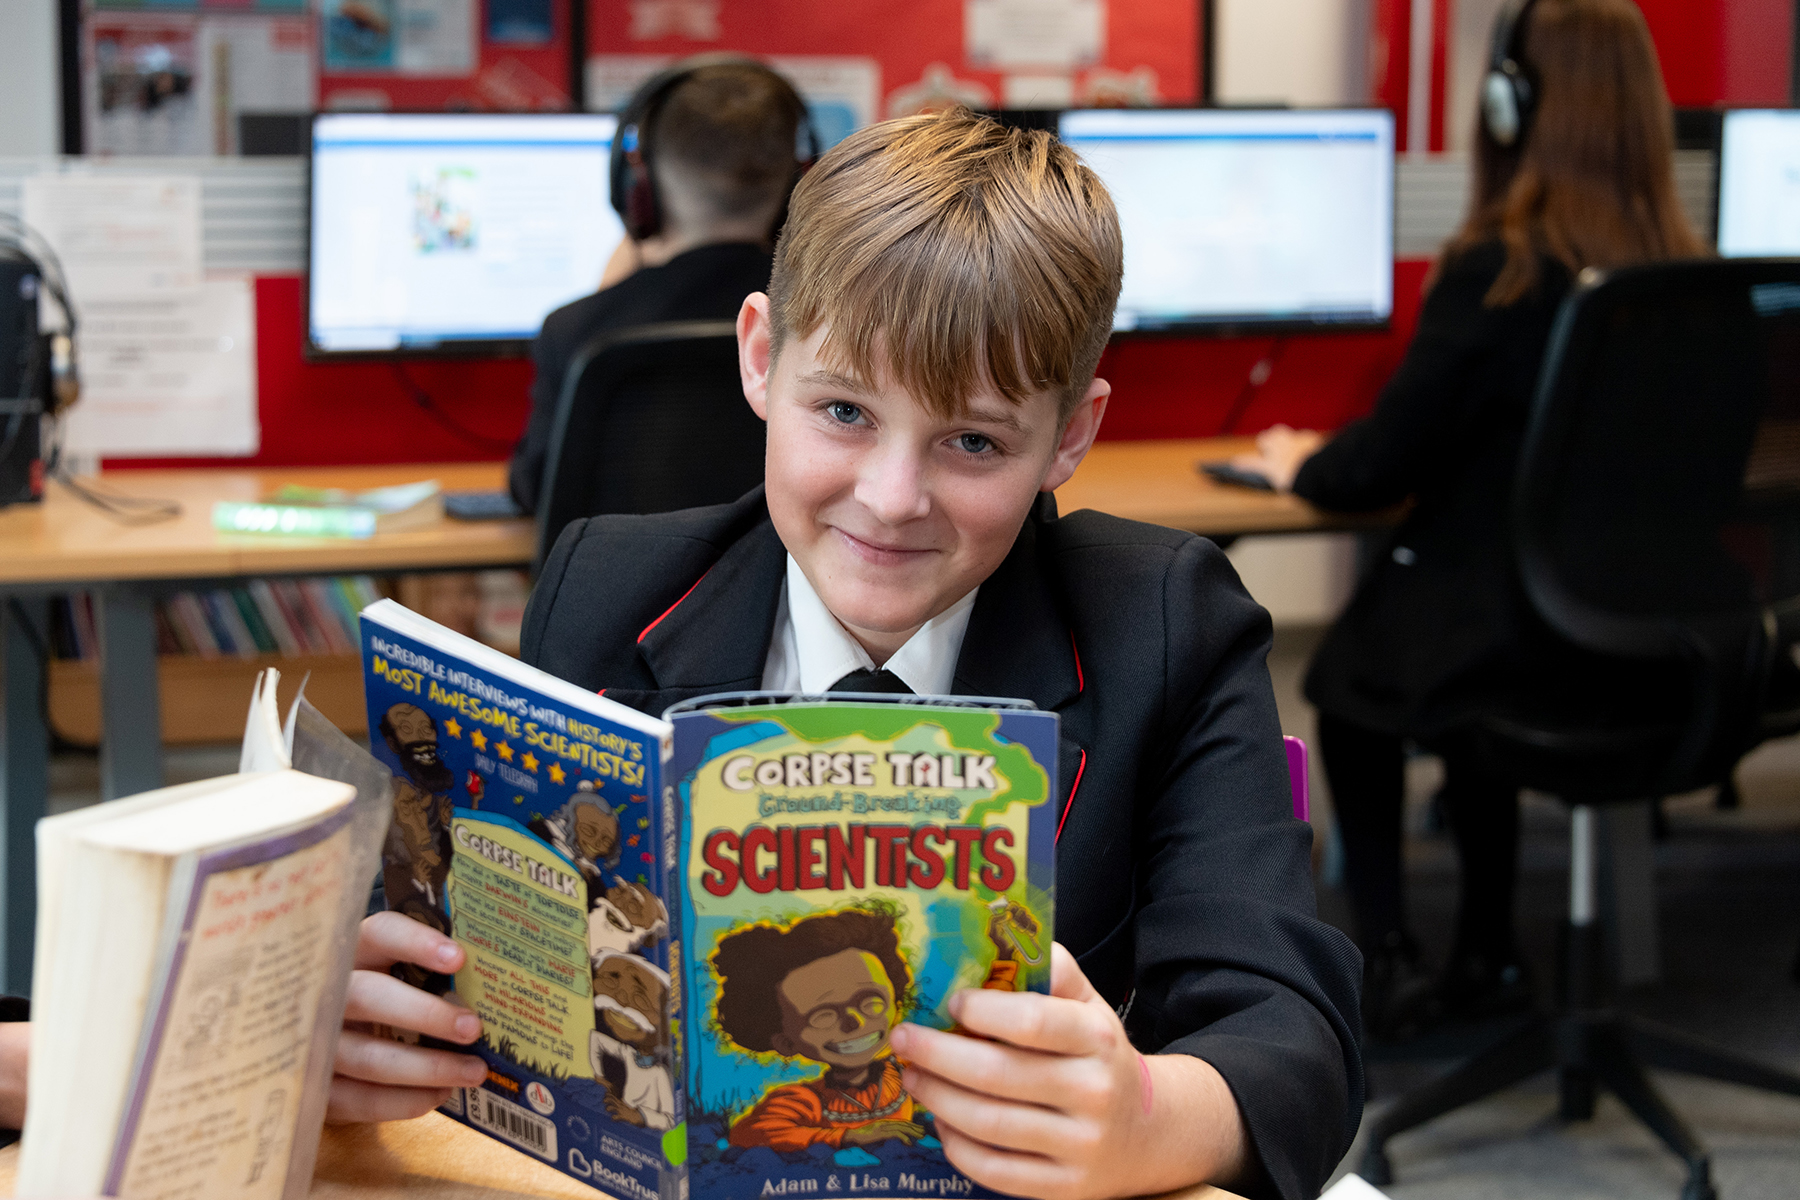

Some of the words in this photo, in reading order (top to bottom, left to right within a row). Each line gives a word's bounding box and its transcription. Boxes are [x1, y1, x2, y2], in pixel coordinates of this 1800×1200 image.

[371, 635, 446, 680] INCREDIBLE
[447, 667, 528, 717] INTERVIEWS
[528, 704, 566, 733] WITH
[567, 717, 642, 761] HISTORY'S
[372, 654, 424, 695] MOST
[427, 679, 522, 738] AWESOME
[523, 721, 645, 788] SCIENTISTS!
[721, 751, 876, 792] CORPSE
[886, 750, 998, 790] TALK
[757, 792, 963, 819] Ground-Breaking
[454, 821, 522, 874] CORPSE
[526, 855, 578, 901] TALK
[701, 823, 1017, 897] SCIENTISTS
[485, 881, 528, 909] DARWIN'S
[494, 873, 520, 893] TASTE
[535, 891, 578, 921] TORTOISE
[498, 905, 539, 933] EINSTEIN
[502, 947, 532, 969] DEADLY
[548, 957, 575, 978] MARIE
[474, 964, 498, 982] MORE
[511, 981, 544, 1004] CORPSE
[510, 969, 526, 984] ALL
[529, 978, 550, 996] THIS
[499, 986, 545, 1016] HILARIOUS
[478, 1009, 498, 1026] DEAD
[501, 1020, 537, 1045] FAMOUS
[601, 1135, 624, 1152] ARTS
[601, 1142, 643, 1171] ENGLAND
[592, 1158, 660, 1200] BookTrus
[761, 1177, 818, 1197] Adam
[825, 1174, 842, 1191] &
[850, 1172, 890, 1191] Lisa
[897, 1172, 974, 1195] Murphy
